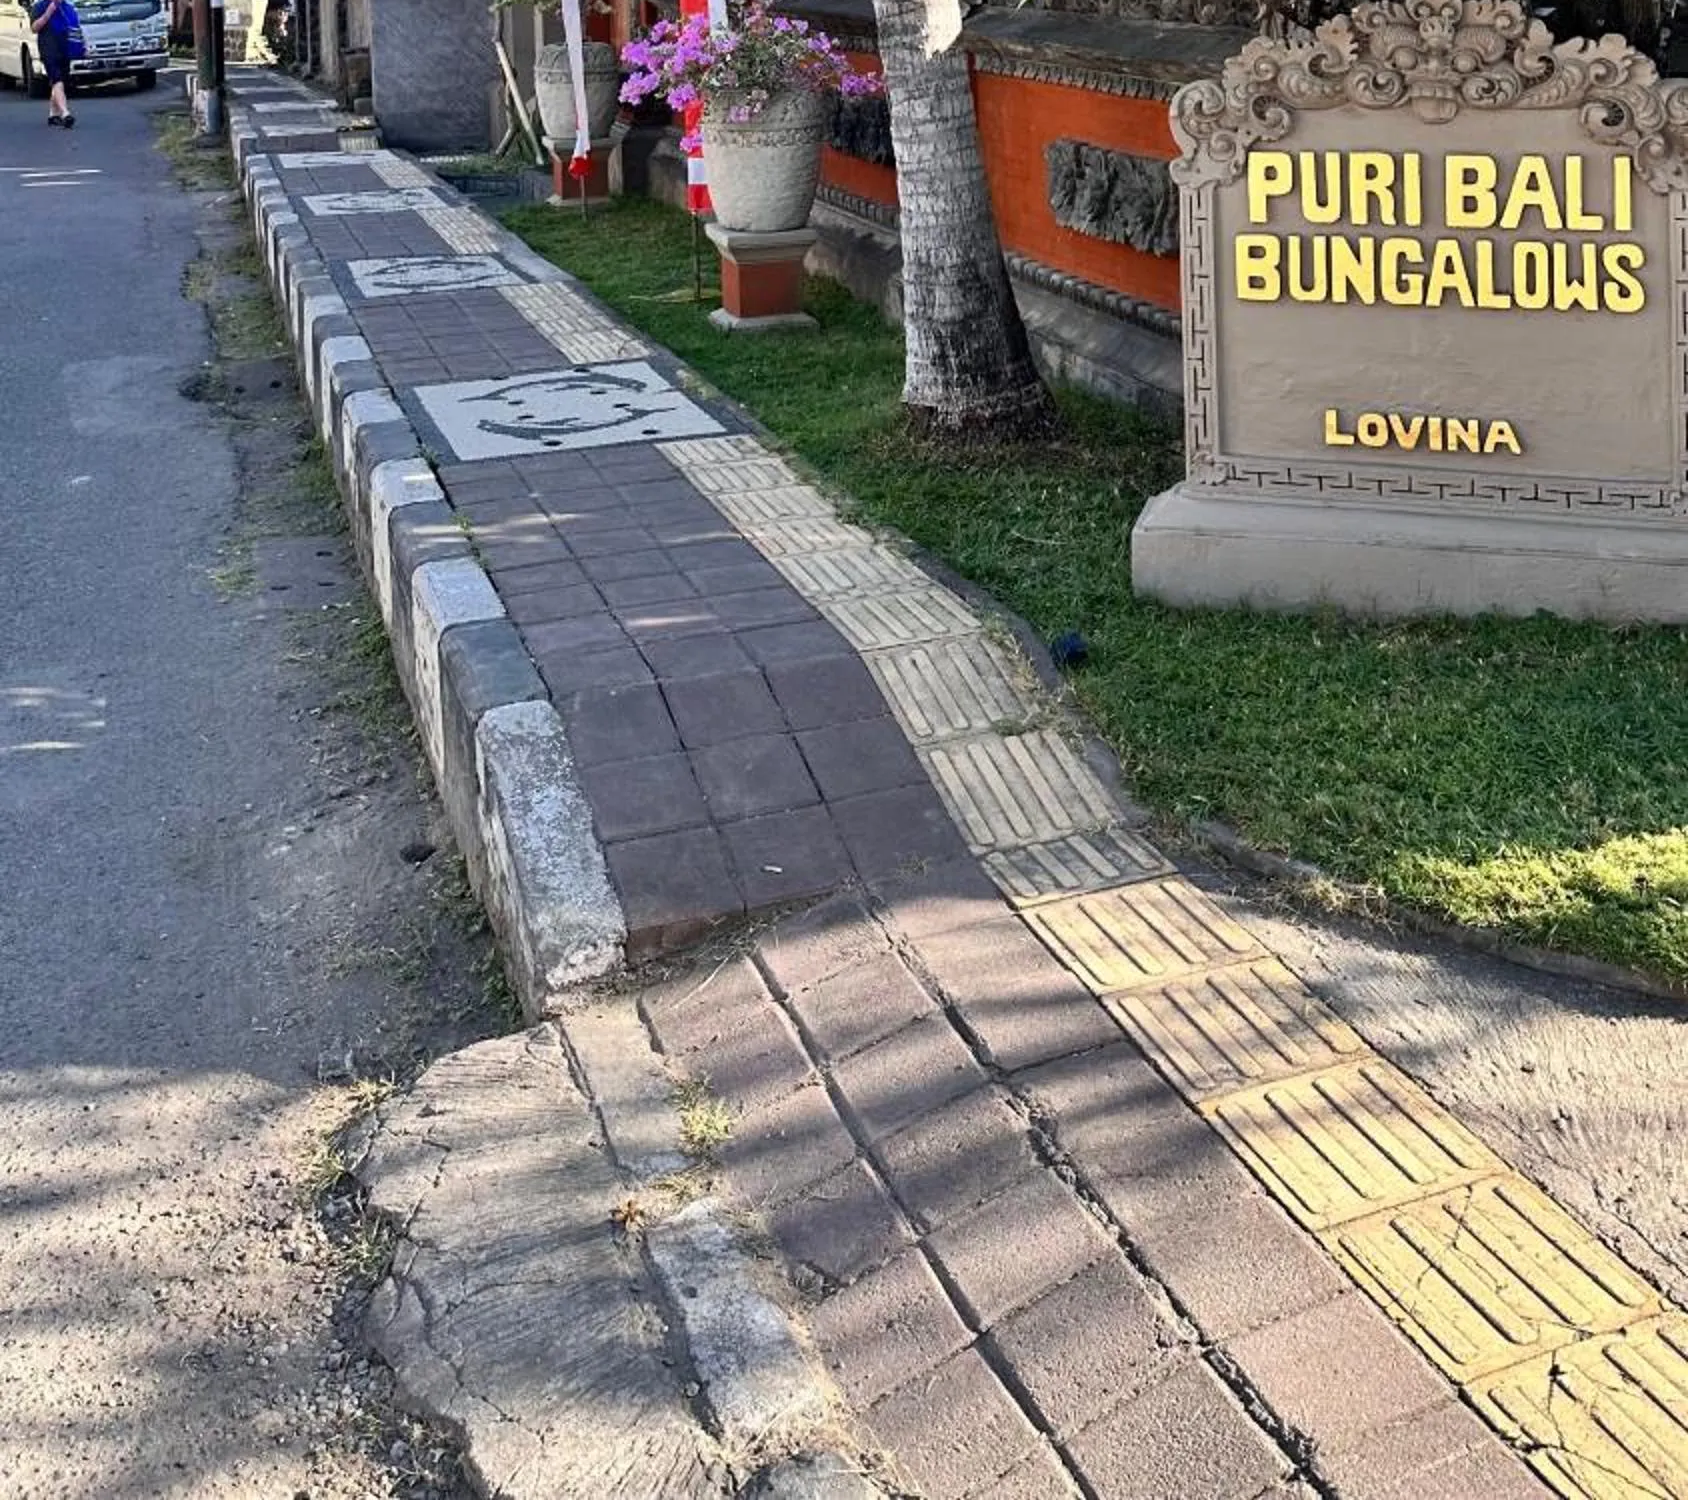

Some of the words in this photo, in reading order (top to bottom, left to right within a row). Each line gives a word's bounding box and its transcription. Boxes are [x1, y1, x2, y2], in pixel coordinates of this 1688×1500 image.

[1246, 150, 1422, 228] PURI
[1444, 154, 1633, 232] BALI
[1234, 233, 1646, 314] BUNGALOWS
[1324, 409, 1522, 455] LOVINA
